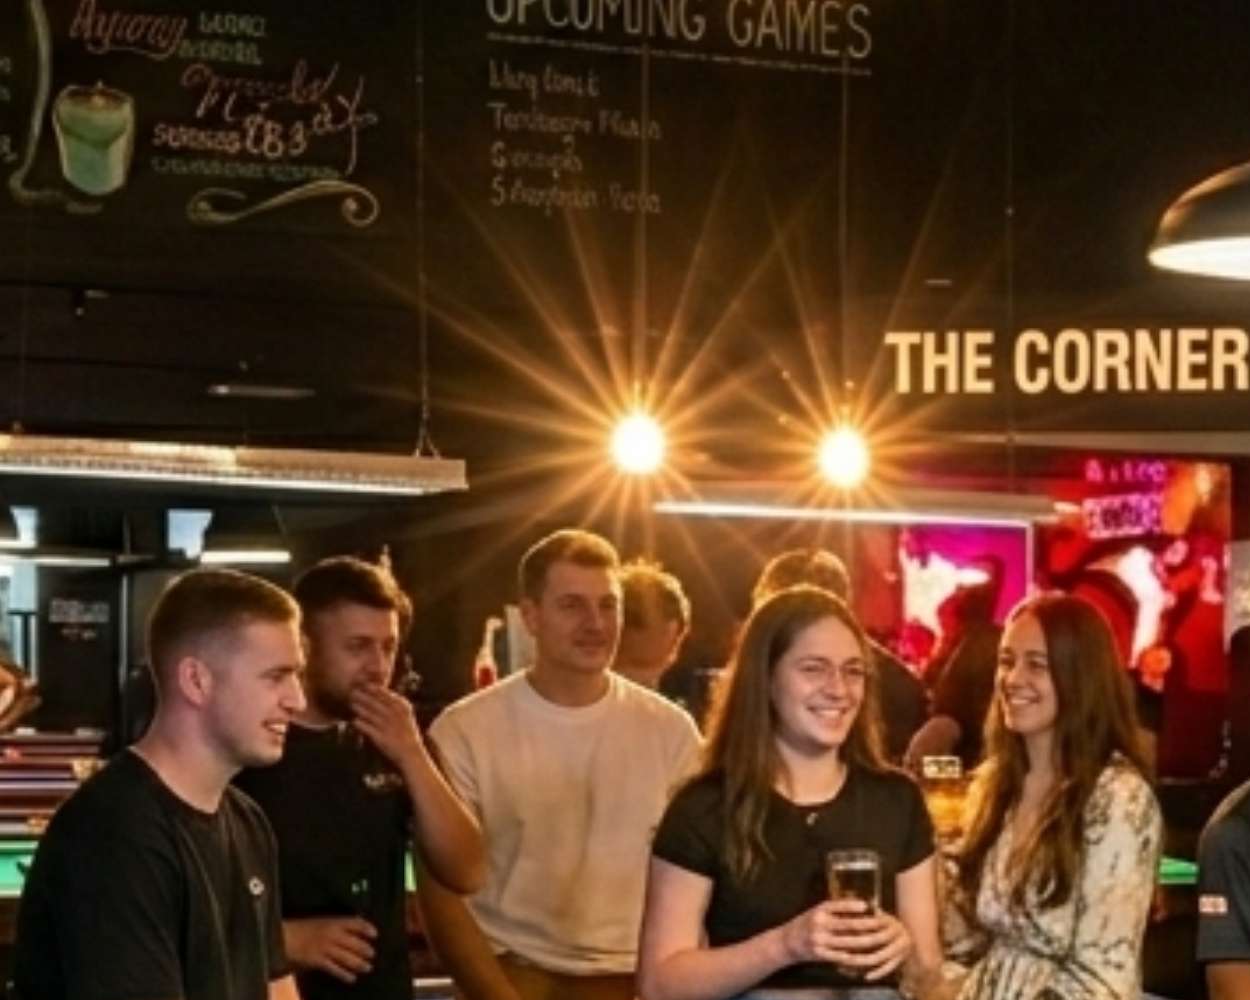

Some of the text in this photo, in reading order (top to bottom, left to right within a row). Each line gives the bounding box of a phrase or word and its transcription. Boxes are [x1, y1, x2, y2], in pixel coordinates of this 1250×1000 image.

[727, 0, 873, 59] GAMES
[884, 331, 995, 395] THE
[1013, 326, 1250, 394] CORNER
